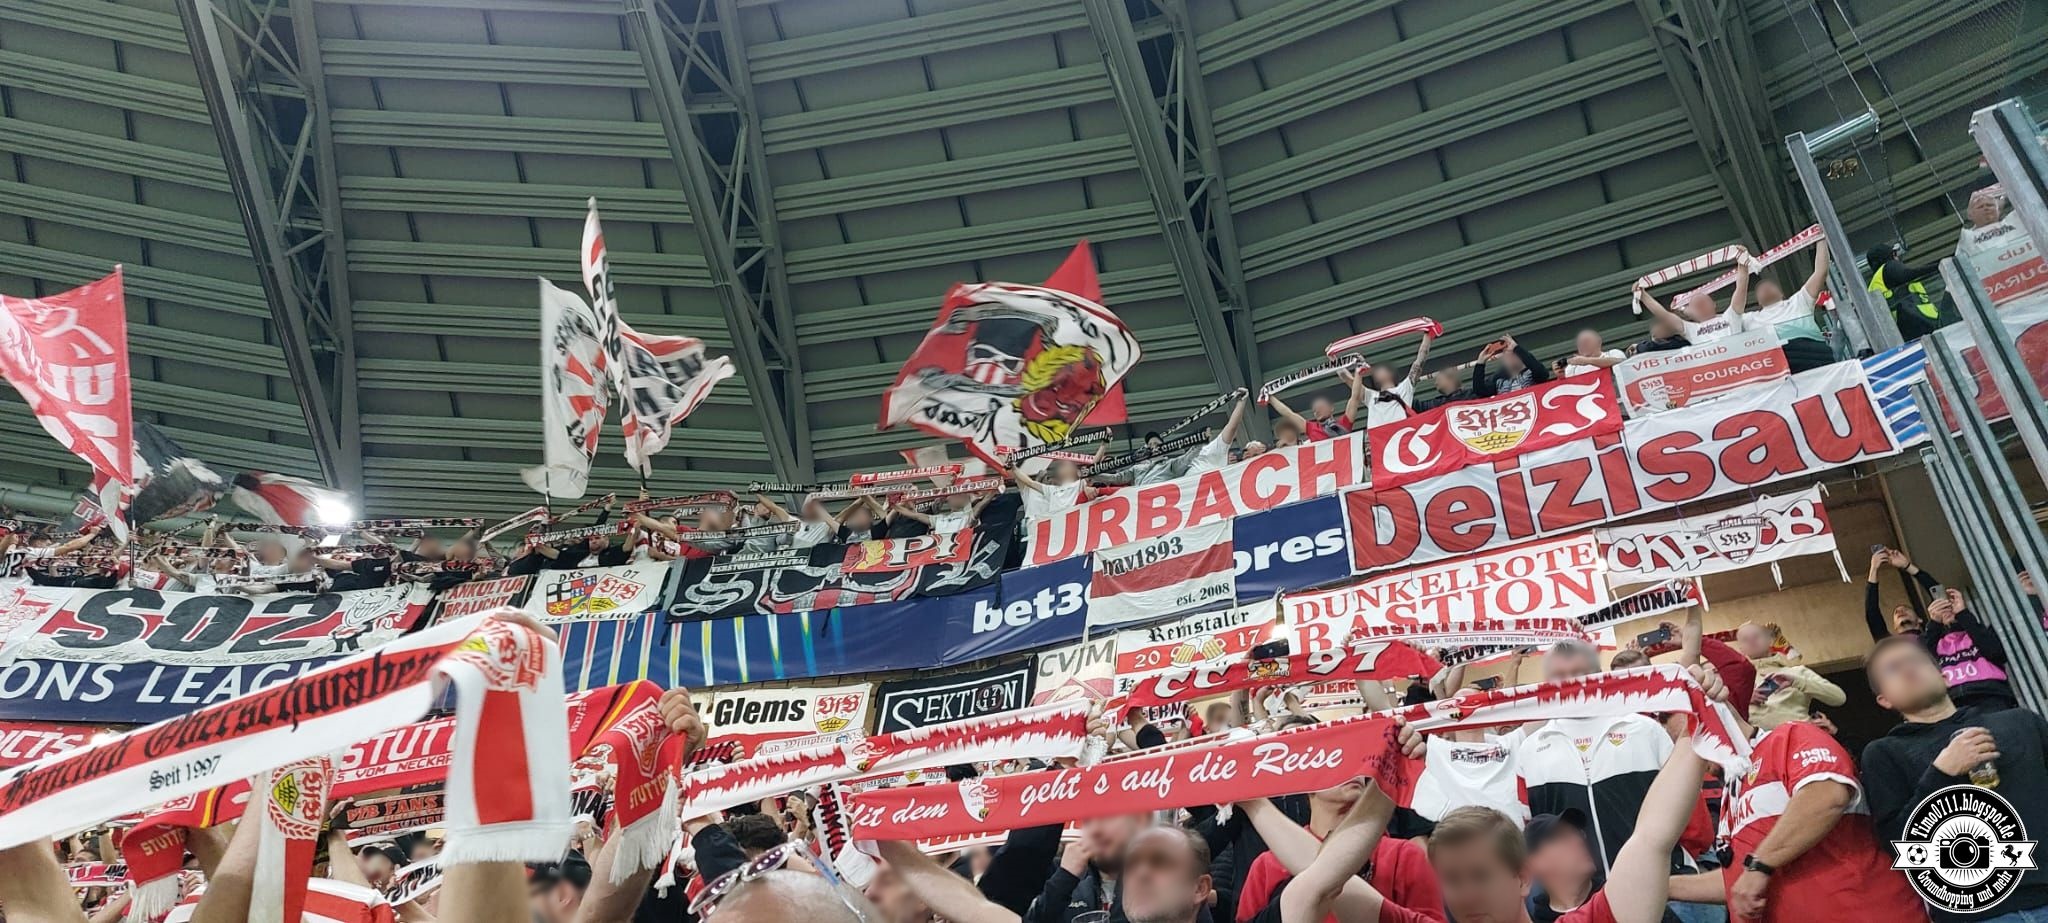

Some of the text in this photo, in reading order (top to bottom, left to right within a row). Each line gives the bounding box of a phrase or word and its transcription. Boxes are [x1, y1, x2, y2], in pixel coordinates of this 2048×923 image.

[1744, 337, 1766, 348] OFC
[1632, 345, 1728, 373] VfB Fanclub
[1692, 357, 1775, 384] COURAGE
[750, 481, 803, 492] Schwaben
[1345, 384, 1895, 571] Deizisau
[1033, 436, 1352, 566] URBACH
[559, 570, 584, 583] DKS
[622, 569, 640, 580] 07
[1293, 541, 1597, 622] DUNKELROTE
[973, 581, 1091, 634] bet3
[1175, 582, 1230, 606] est. 2008
[1294, 568, 1599, 653] BASTION
[1149, 610, 1250, 643] Remstaler
[1238, 629, 1261, 648] 17
[1039, 639, 1114, 678] CVJM
[1133, 652, 1161, 669] 20
[1307, 641, 1394, 675] 97
[136, 661, 312, 704] LEAG
[714, 697, 807, 727] Glems
[816, 694, 861, 715] VfB
[758, 743, 781, 757] Bad
[149, 754, 223, 792] Seit 1997
[356, 765, 387, 779] VOM
[892, 798, 949, 825] dem
[1020, 768, 1082, 818] geht
[1121, 756, 1176, 799] auf
[1189, 749, 1239, 781] die
[1251, 740, 1344, 777] Reise
[386, 795, 438, 814] FANS
